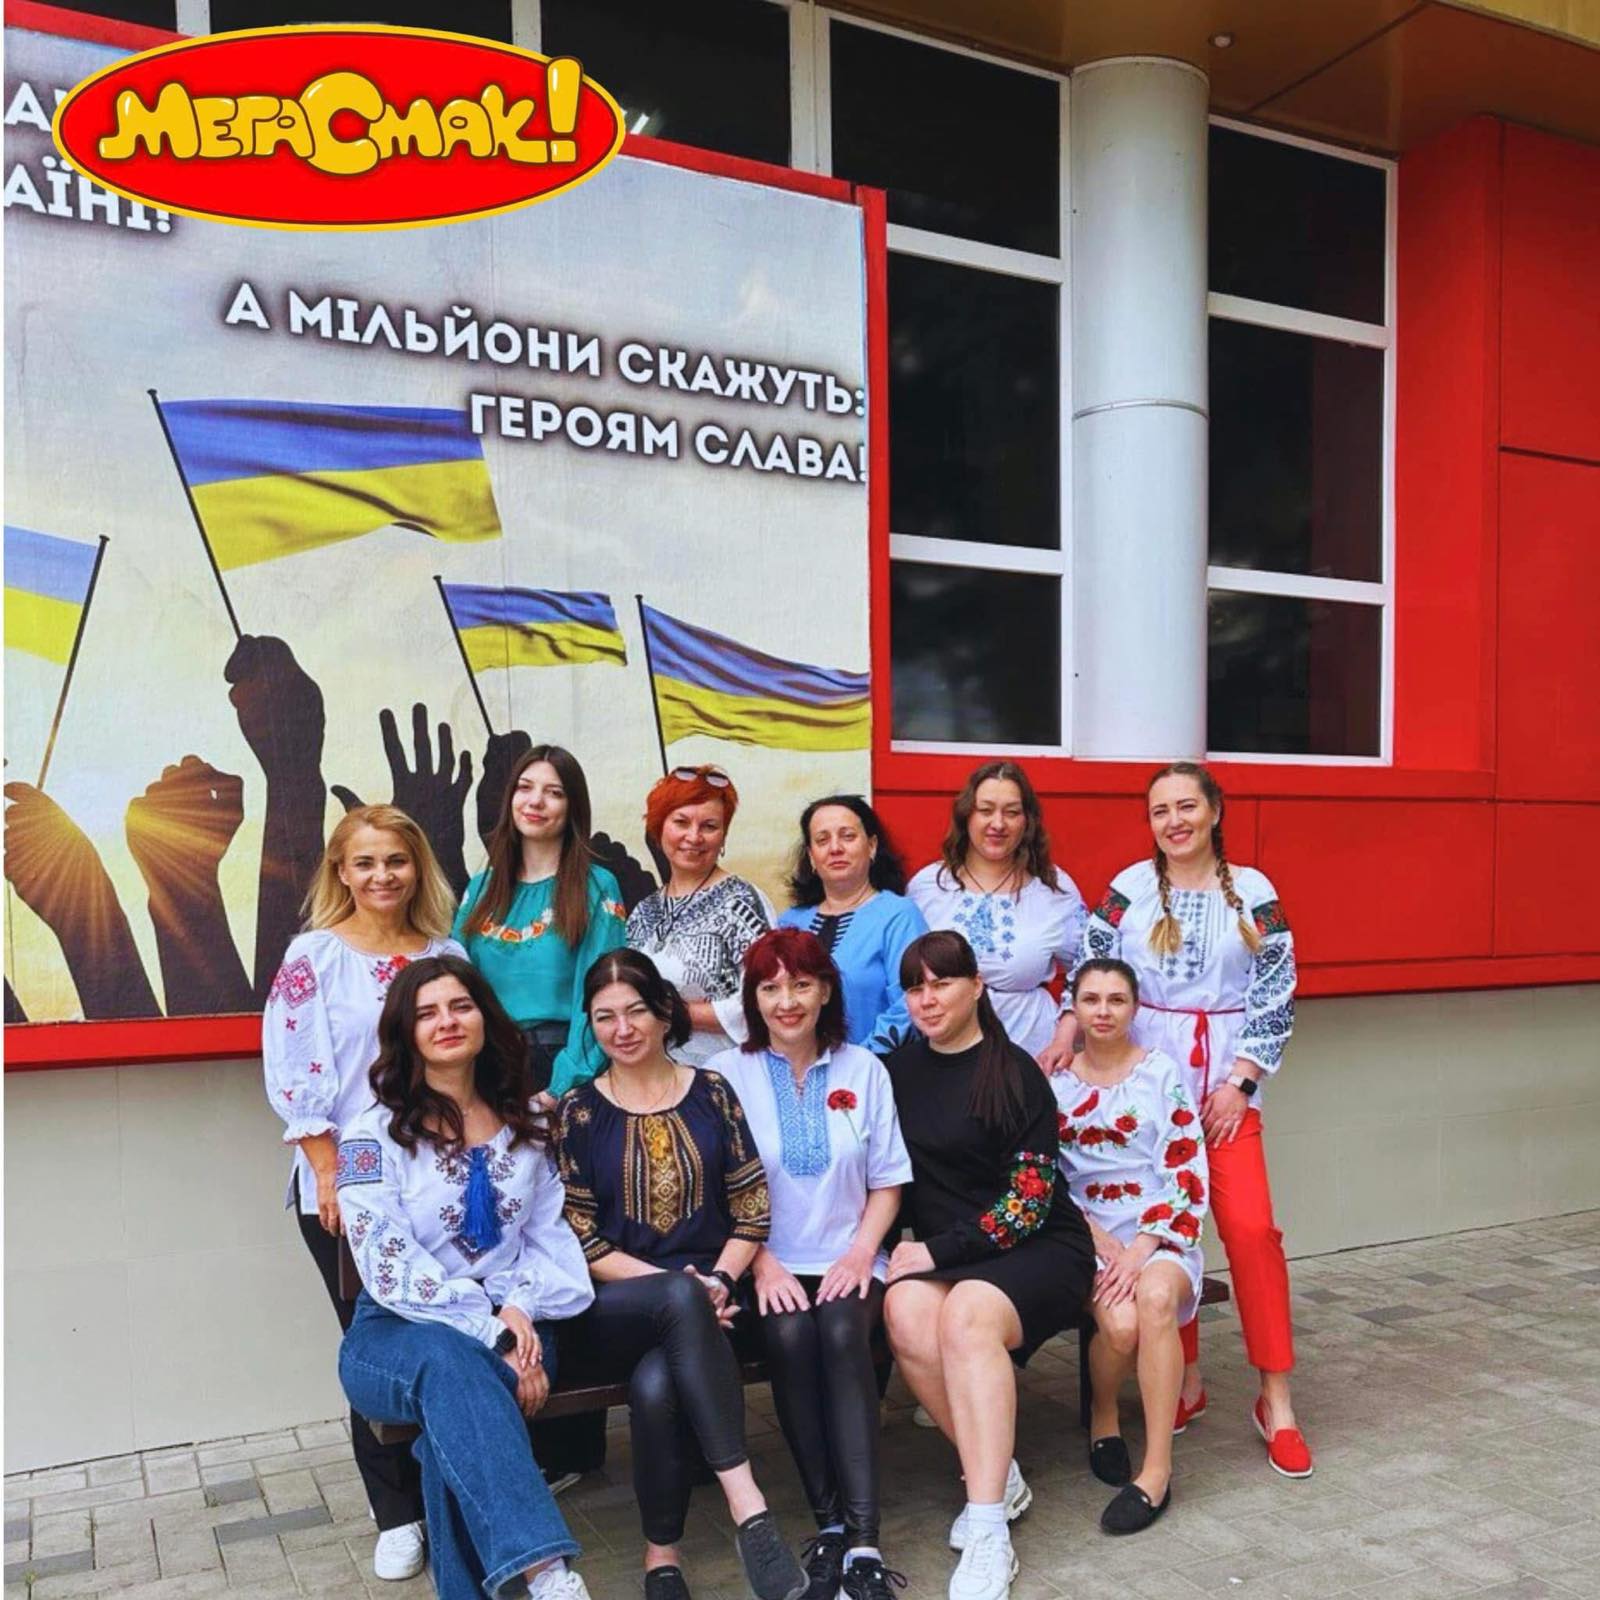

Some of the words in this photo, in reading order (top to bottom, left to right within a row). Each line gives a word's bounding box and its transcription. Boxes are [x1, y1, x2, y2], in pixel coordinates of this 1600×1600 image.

[225, 282, 271, 330] А
[288, 290, 600, 376] МІЛЬЙОНИ
[618, 343, 865, 416] СКАЖУТЬ:
[470, 393, 678, 458] ГЕРОЯМ
[695, 424, 867, 482] СЛАВА!
